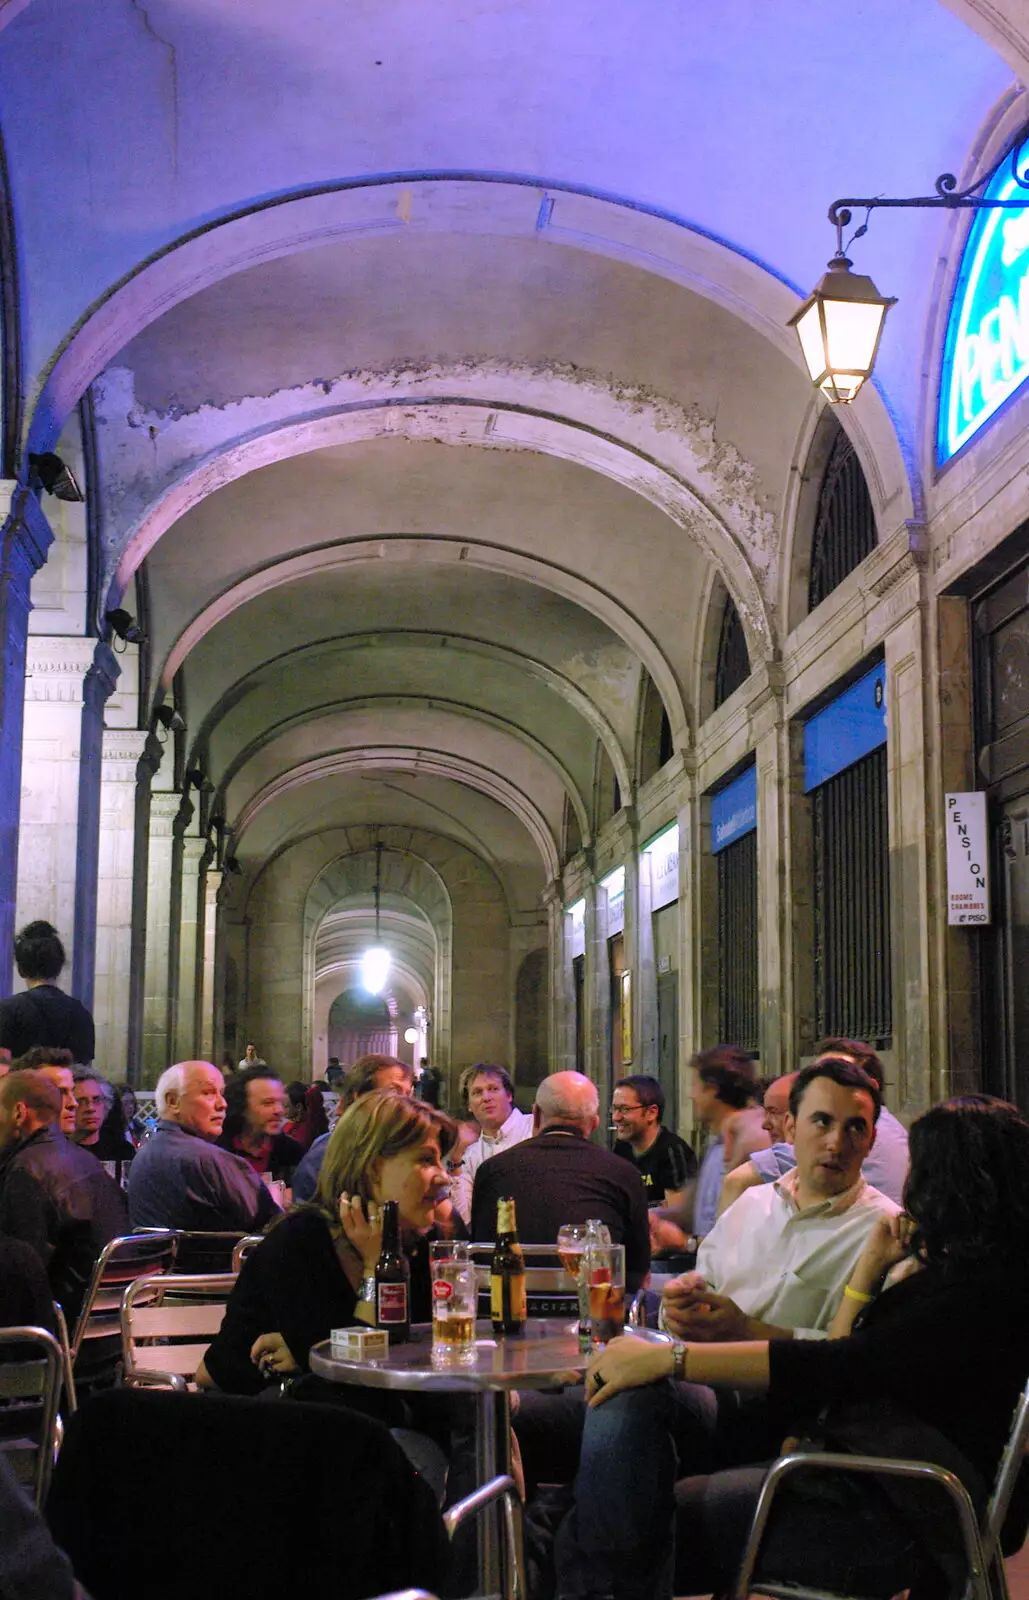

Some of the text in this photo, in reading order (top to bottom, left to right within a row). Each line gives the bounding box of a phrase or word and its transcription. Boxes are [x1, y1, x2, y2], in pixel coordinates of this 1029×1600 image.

[948, 798, 985, 888] PENSION
[967, 914, 987, 922] PISO
[529, 1303, 578, 1312] ACIAR
